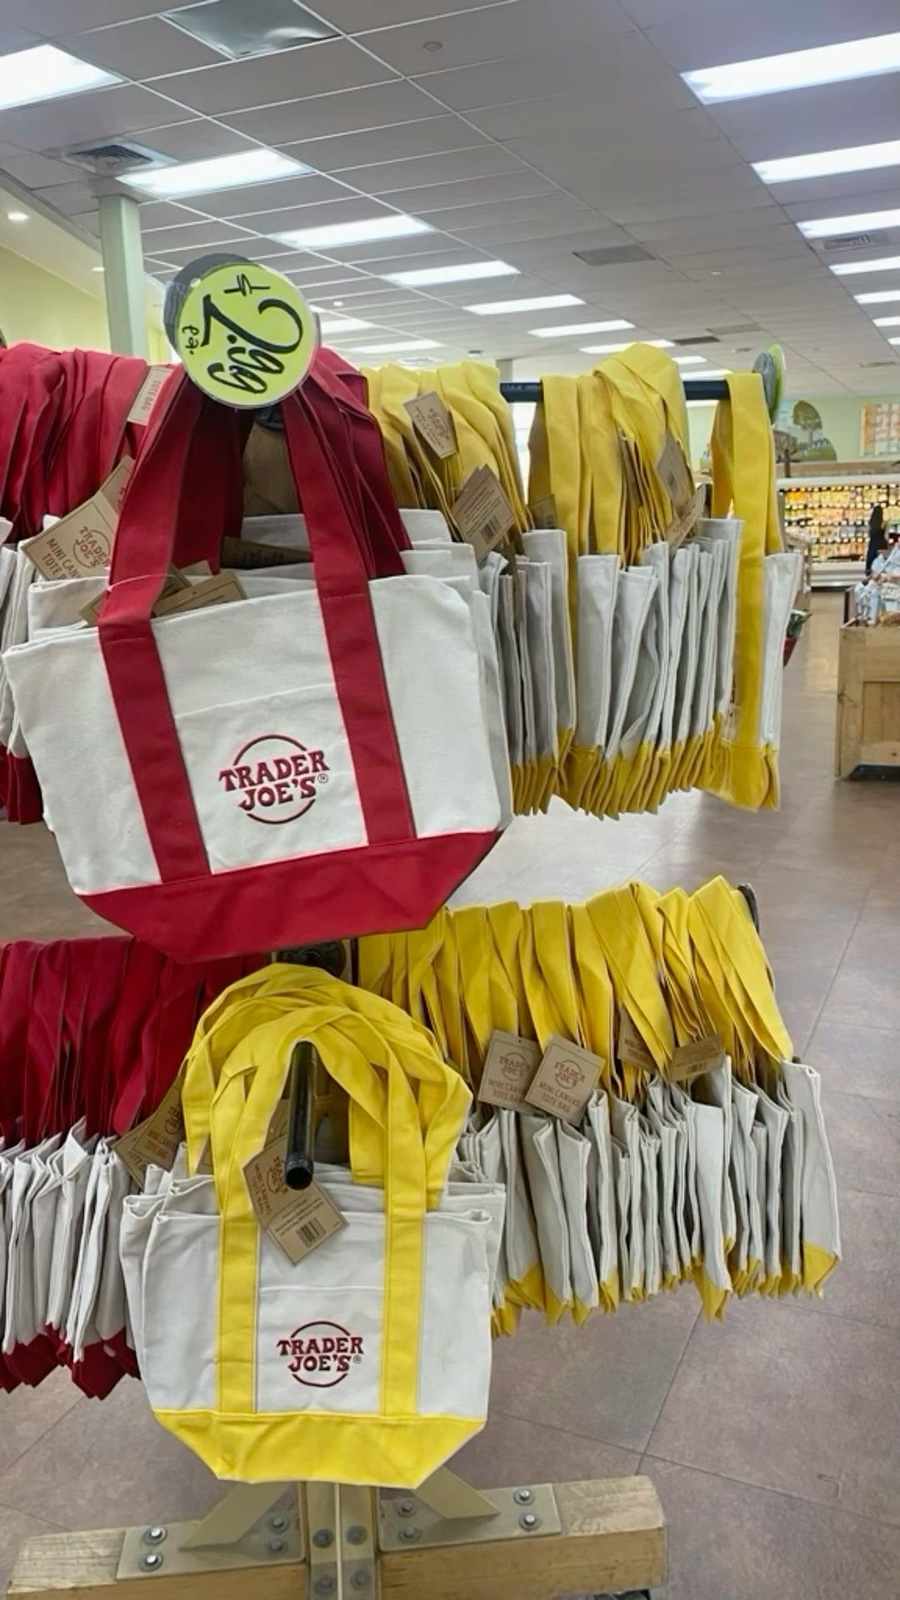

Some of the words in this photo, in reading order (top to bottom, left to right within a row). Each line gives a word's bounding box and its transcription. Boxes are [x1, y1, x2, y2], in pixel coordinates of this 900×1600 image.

[200, 273, 303, 394] $2.99
[42, 553, 62, 576] TOTE
[46, 538, 67, 561] MINI
[62, 559, 82, 579] CAN
[75, 538, 100, 567] JOE'S
[79, 526, 111, 567] TRADER
[218, 750, 331, 792] TRADER
[276, 1336, 364, 1356] TRADER
